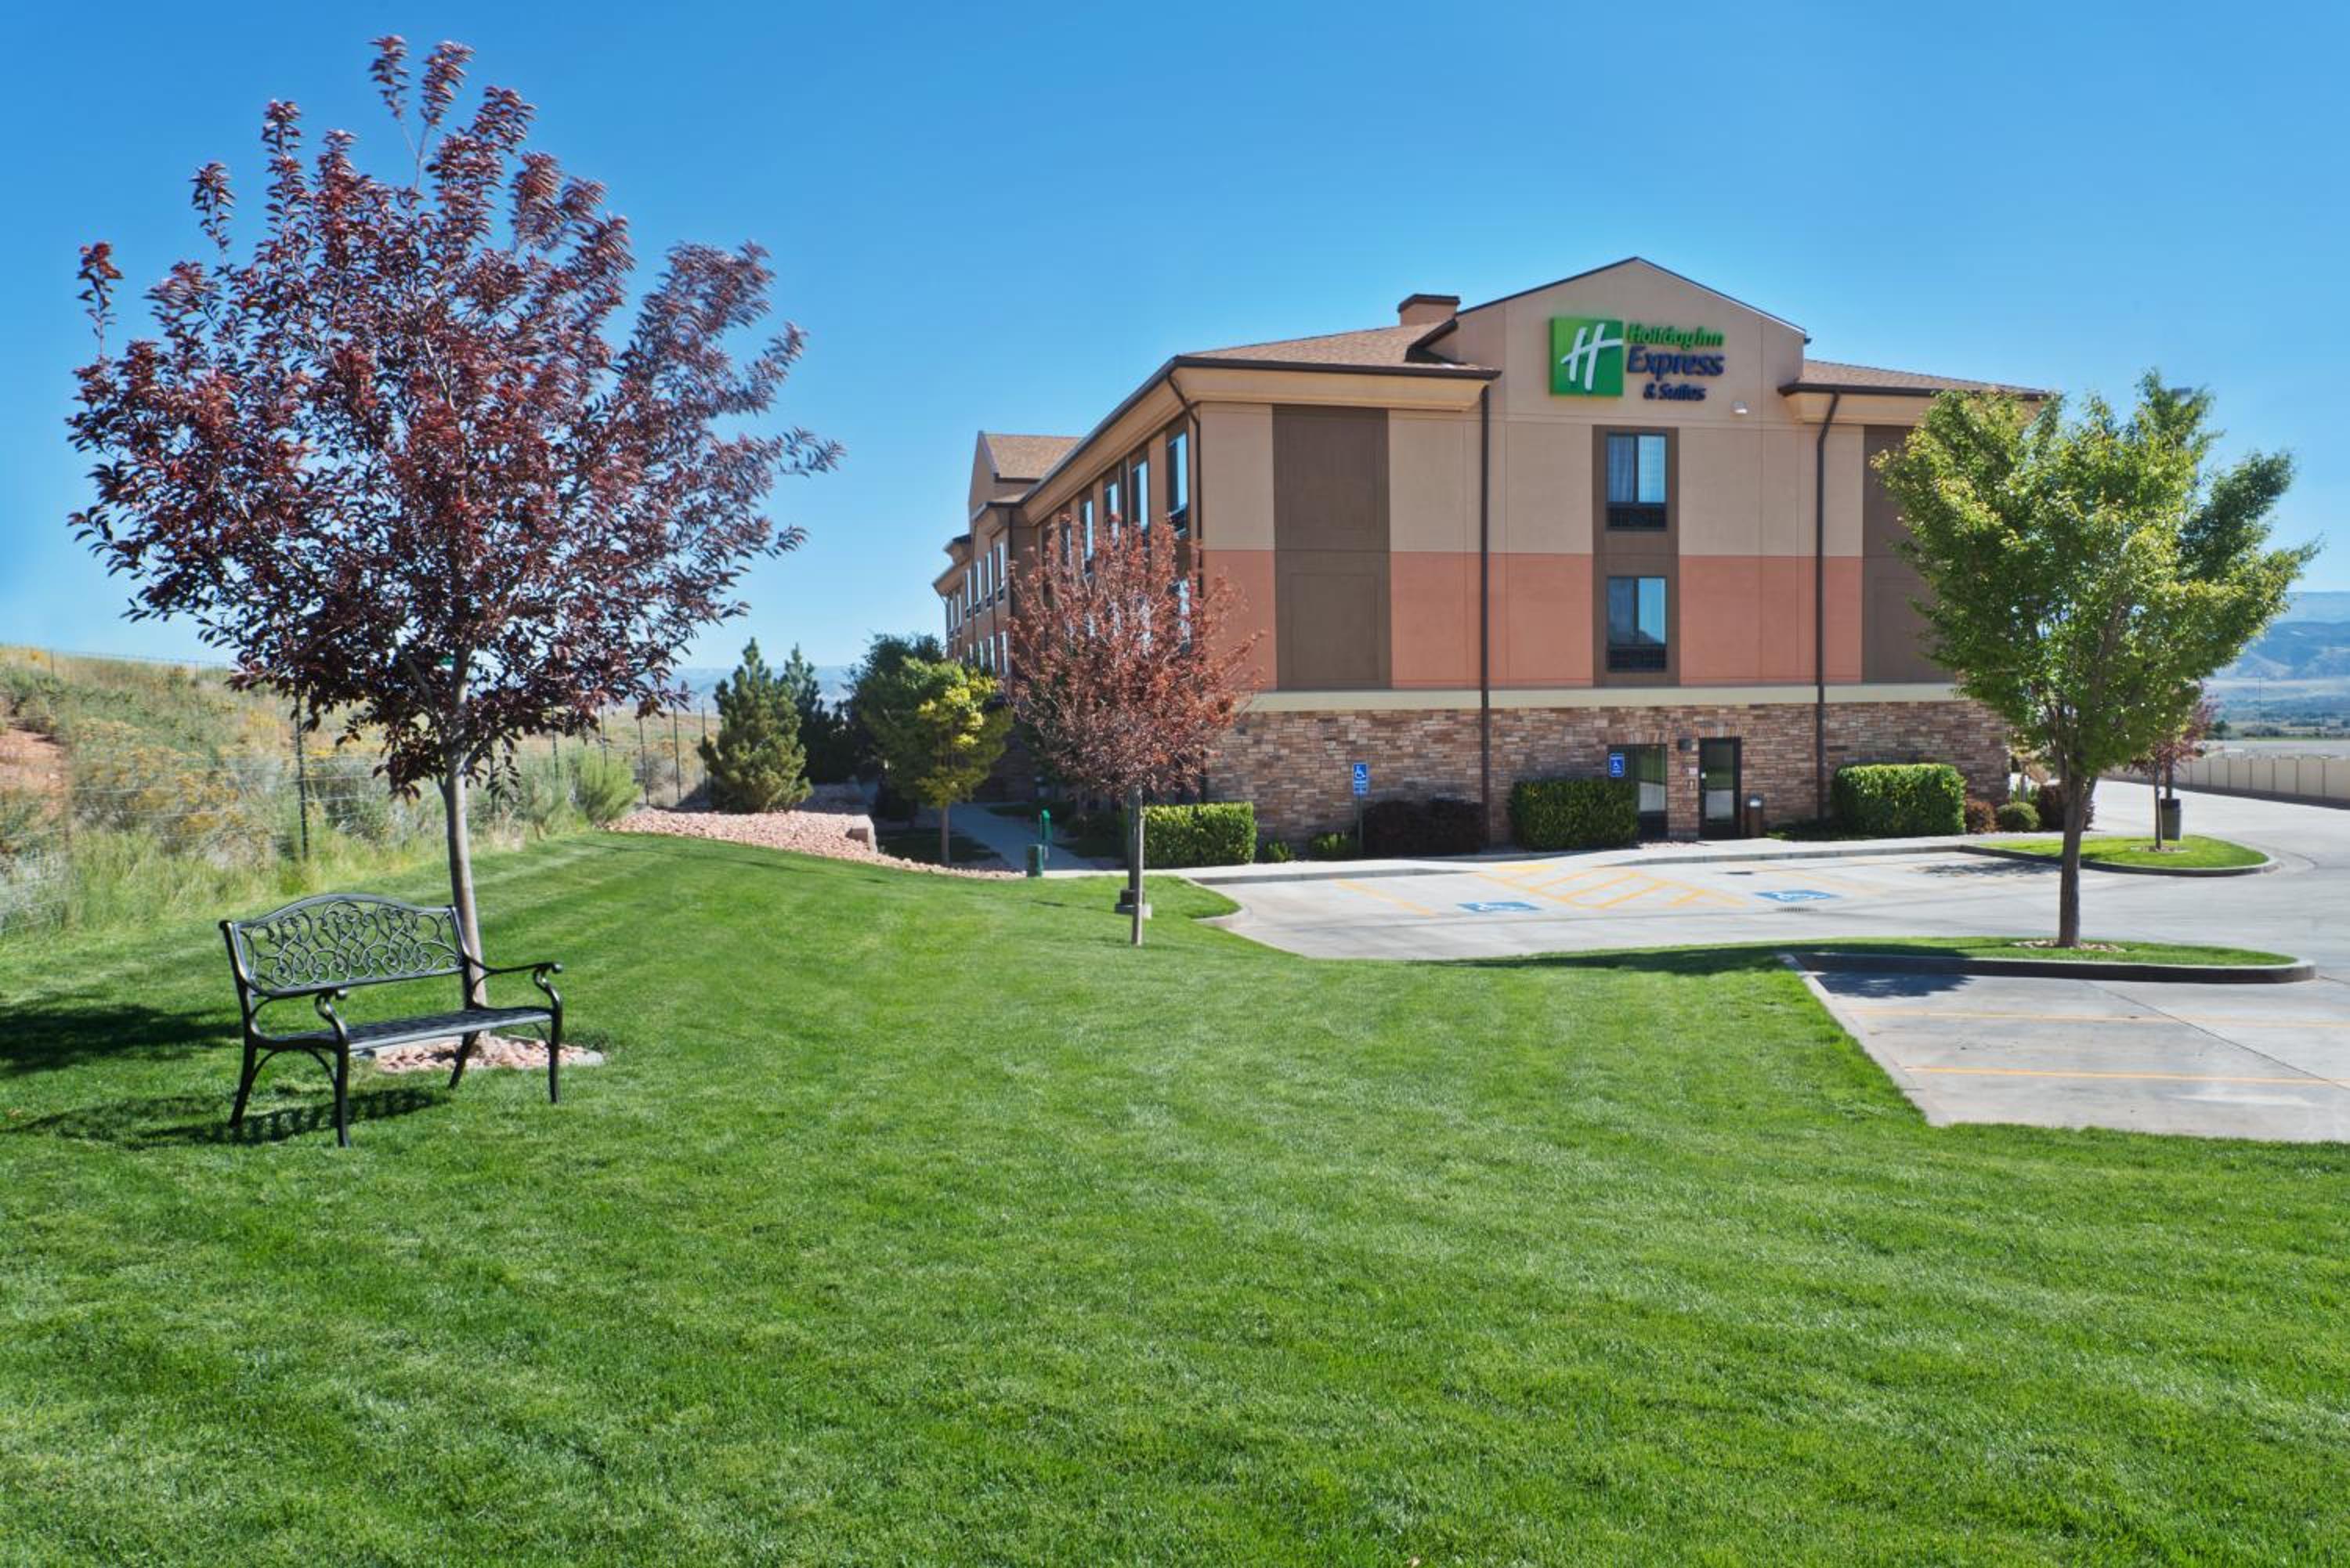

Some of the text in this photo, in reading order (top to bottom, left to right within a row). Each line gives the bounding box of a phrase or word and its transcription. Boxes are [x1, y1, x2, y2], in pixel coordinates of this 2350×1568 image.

[1627, 323, 1694, 350] Holiday
[1627, 345, 1726, 381] Express
[1643, 383, 1706, 401] & Suites
